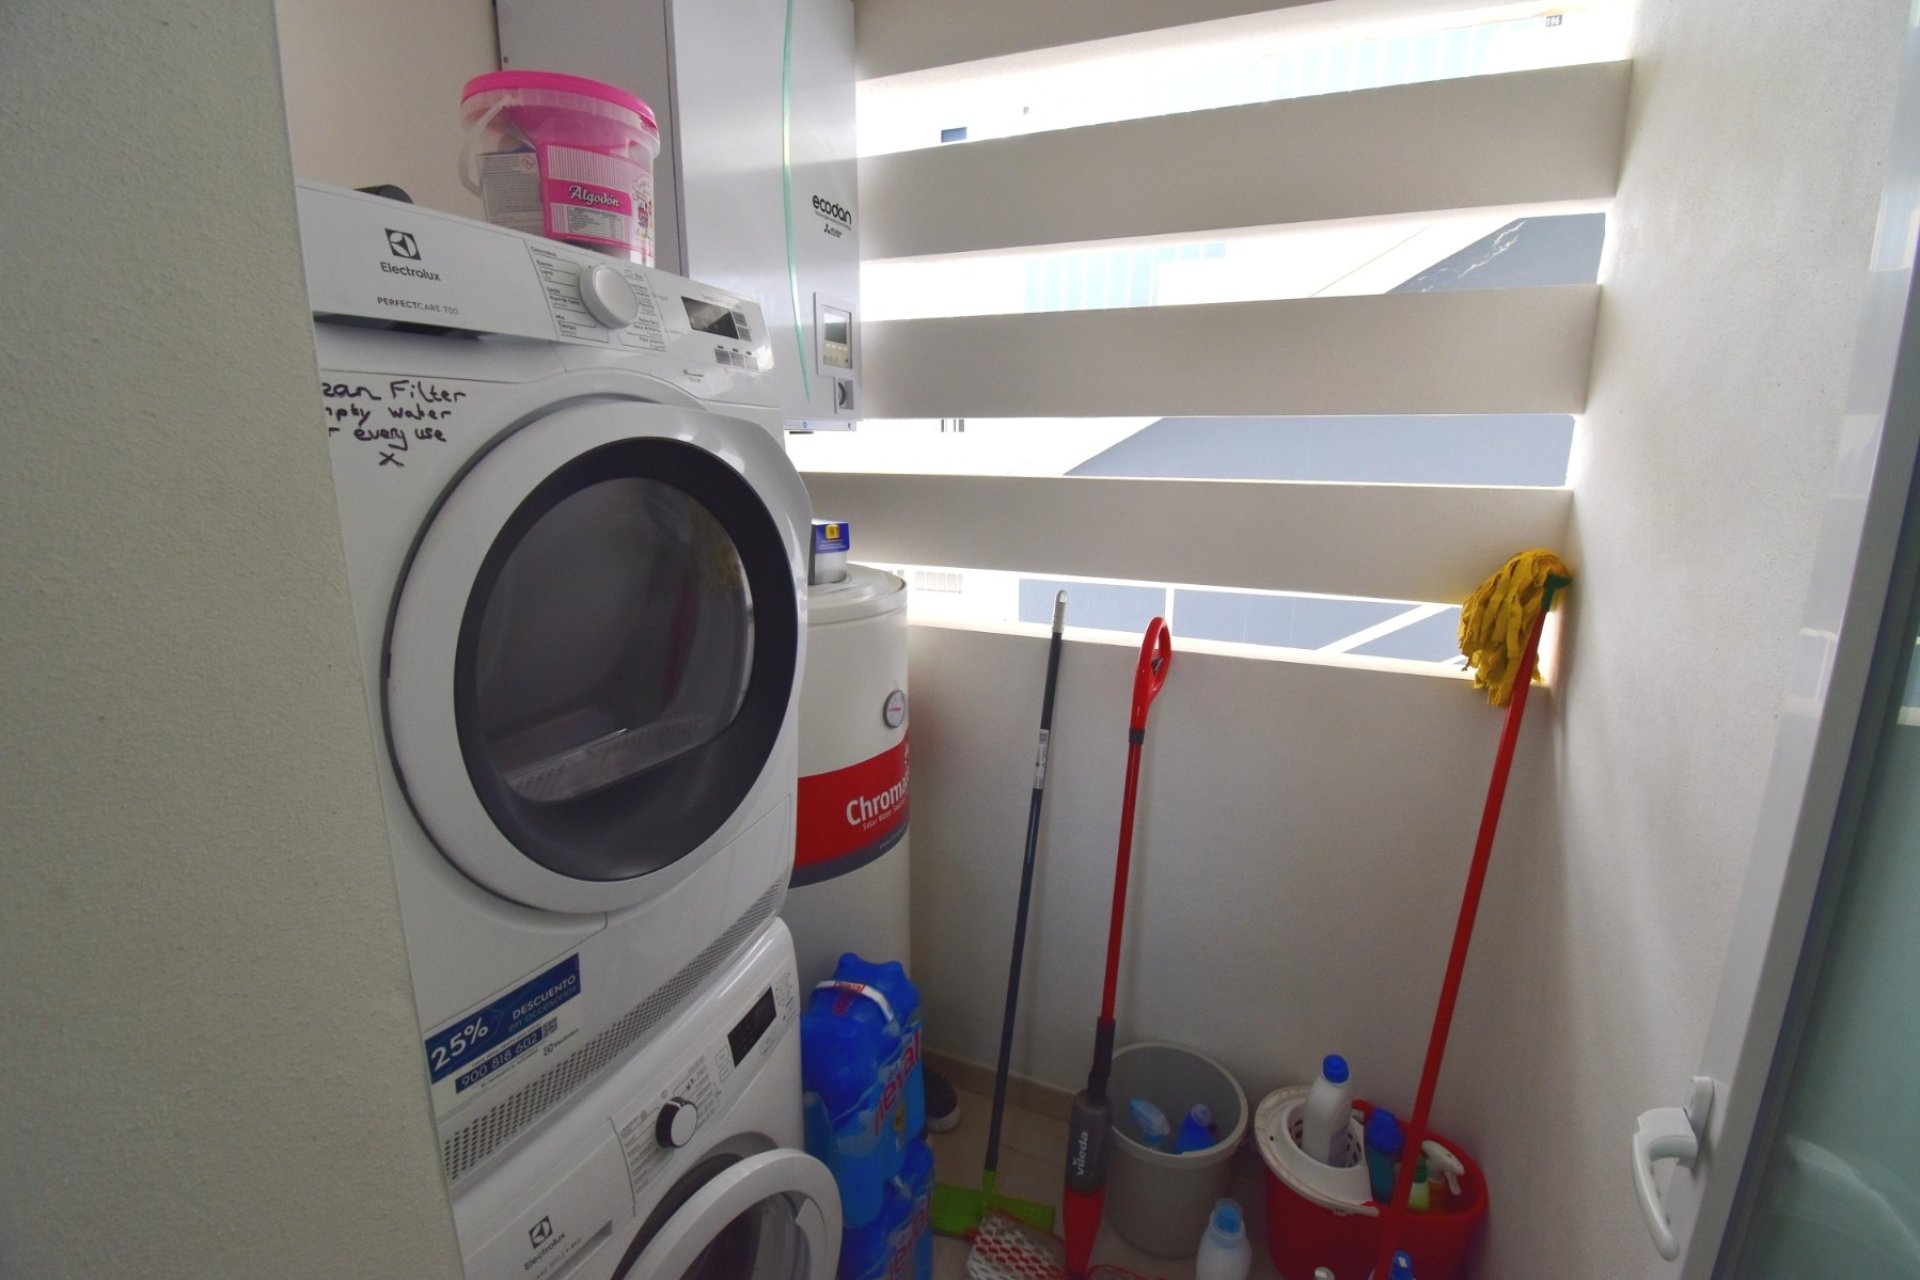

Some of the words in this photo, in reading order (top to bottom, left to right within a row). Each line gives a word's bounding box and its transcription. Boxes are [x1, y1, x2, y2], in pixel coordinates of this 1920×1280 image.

[812, 194, 852, 225] ecodan
[380, 261, 441, 281] Electrolux
[377, 296, 441, 313] PERFECTCARE
[443, 305, 459, 315] 700
[390, 380, 466, 402] Filter
[388, 403, 451, 420] water
[354, 427, 408, 451] every
[415, 428, 447, 442] use
[512, 975, 576, 1020] DESCUENTO
[431, 1017, 488, 1072] 25%
[461, 1066, 488, 1086] 900
[491, 1050, 511, 1069] 818
[515, 1033, 538, 1054] 602
[1074, 1130, 1089, 1175] vileda
[524, 1232, 566, 1270] Electrolux
